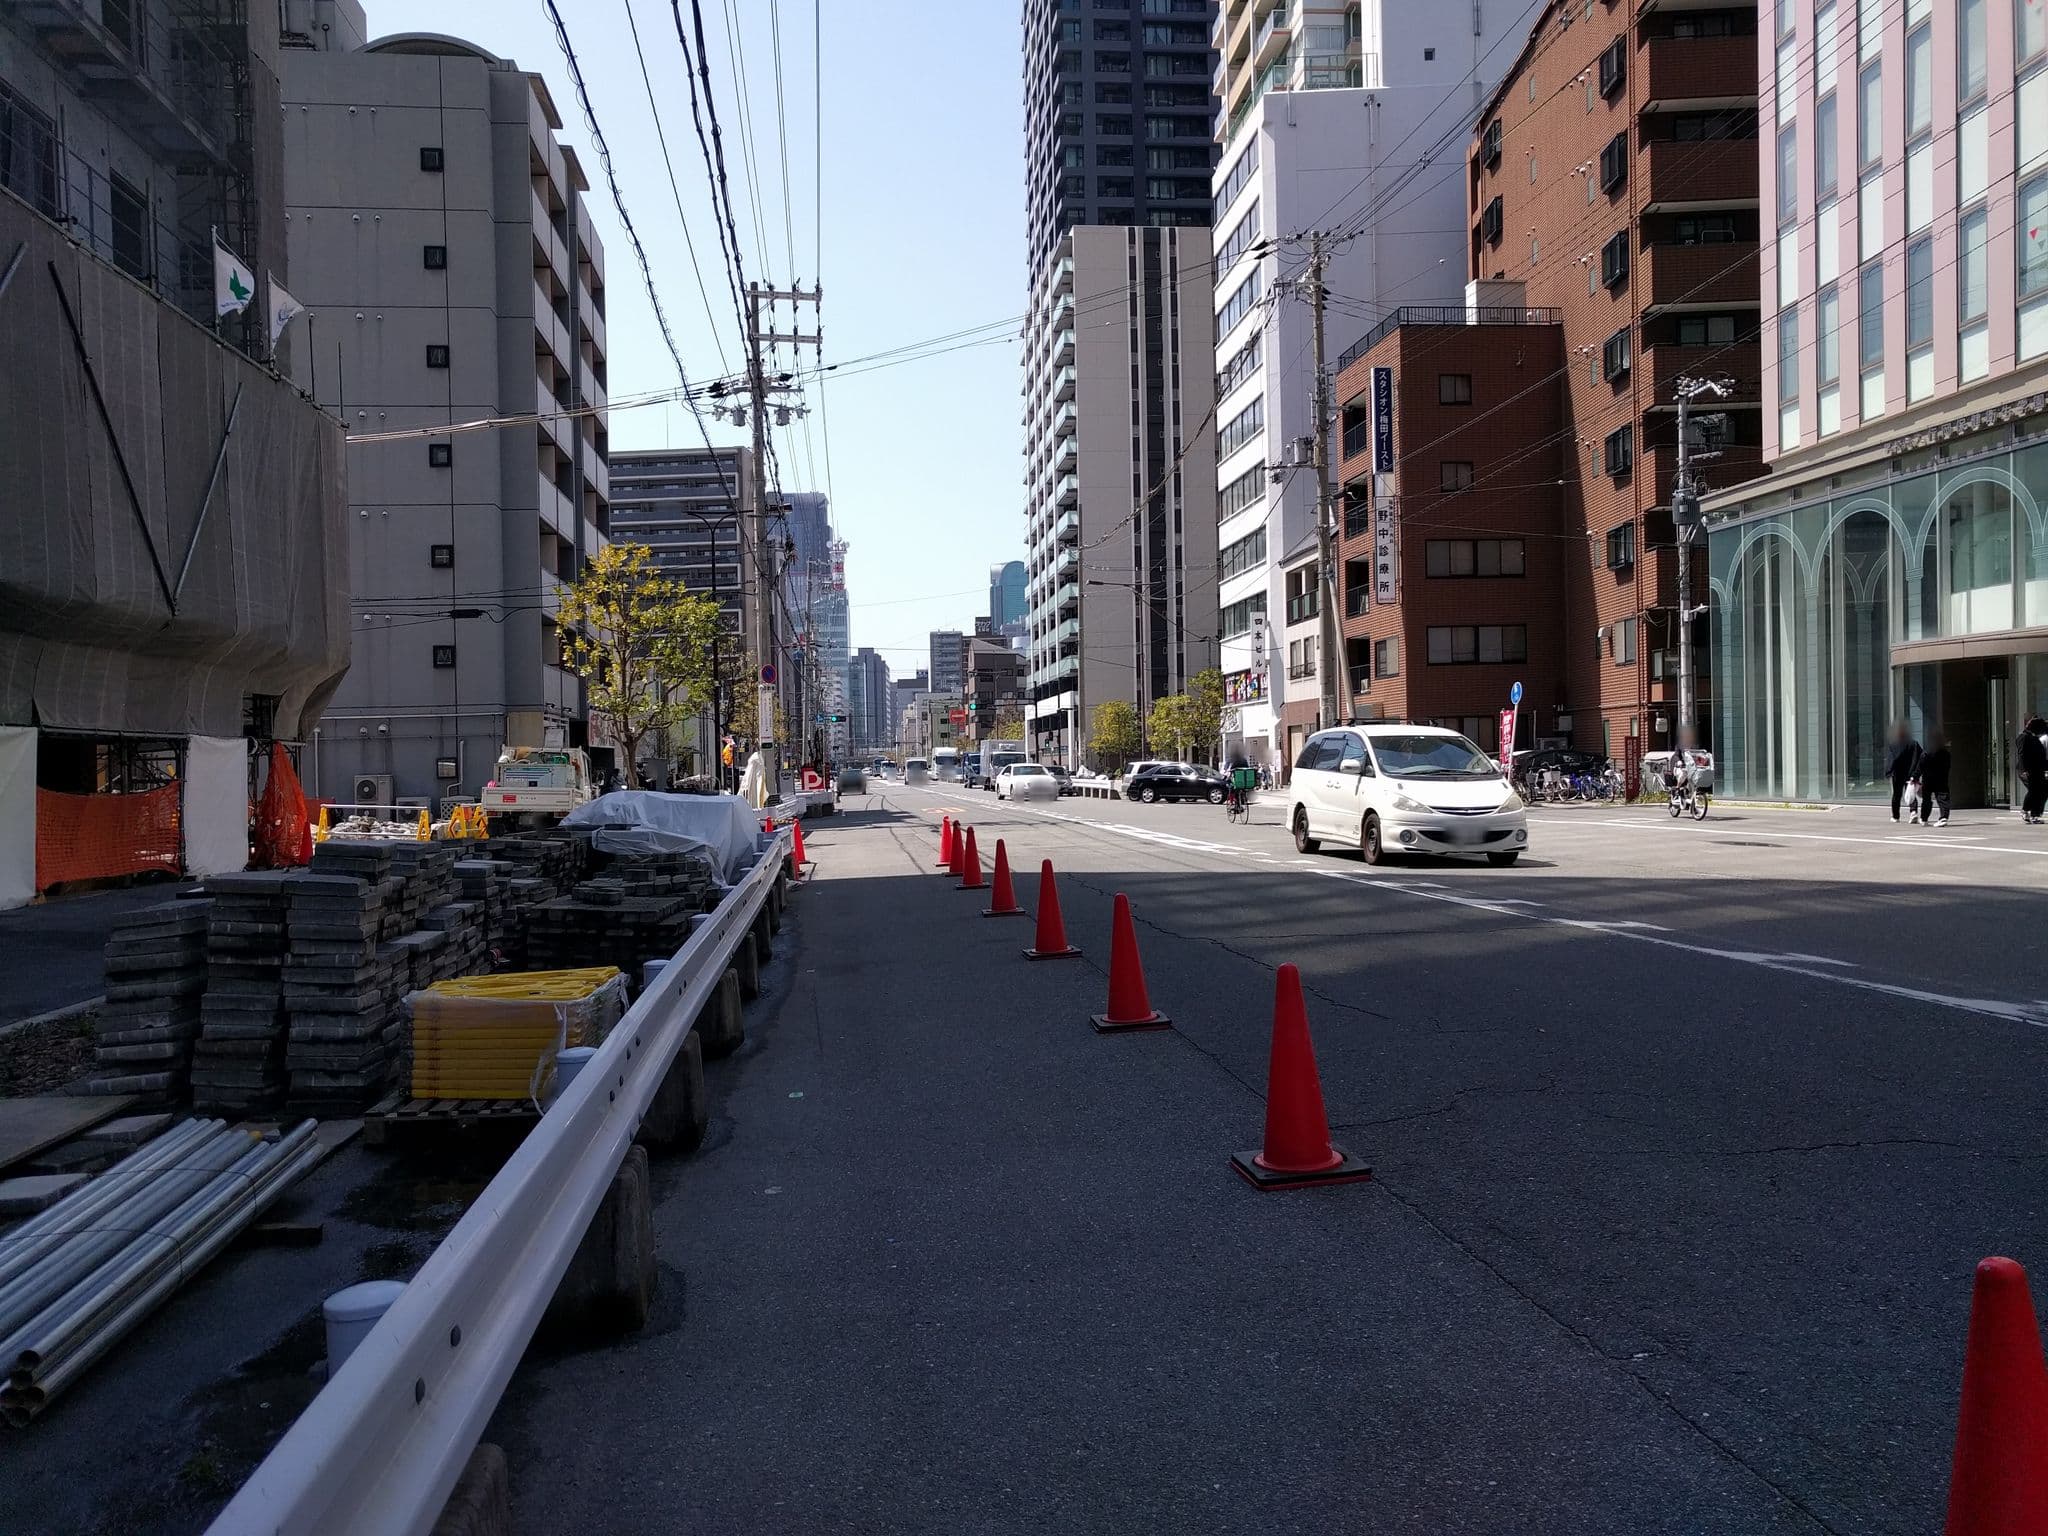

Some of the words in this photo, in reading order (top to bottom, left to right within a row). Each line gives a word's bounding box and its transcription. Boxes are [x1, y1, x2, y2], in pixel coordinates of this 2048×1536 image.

[1379, 371, 1389, 470] スタシオン梅田イースト
[1377, 509, 1390, 593] 野中診療所
